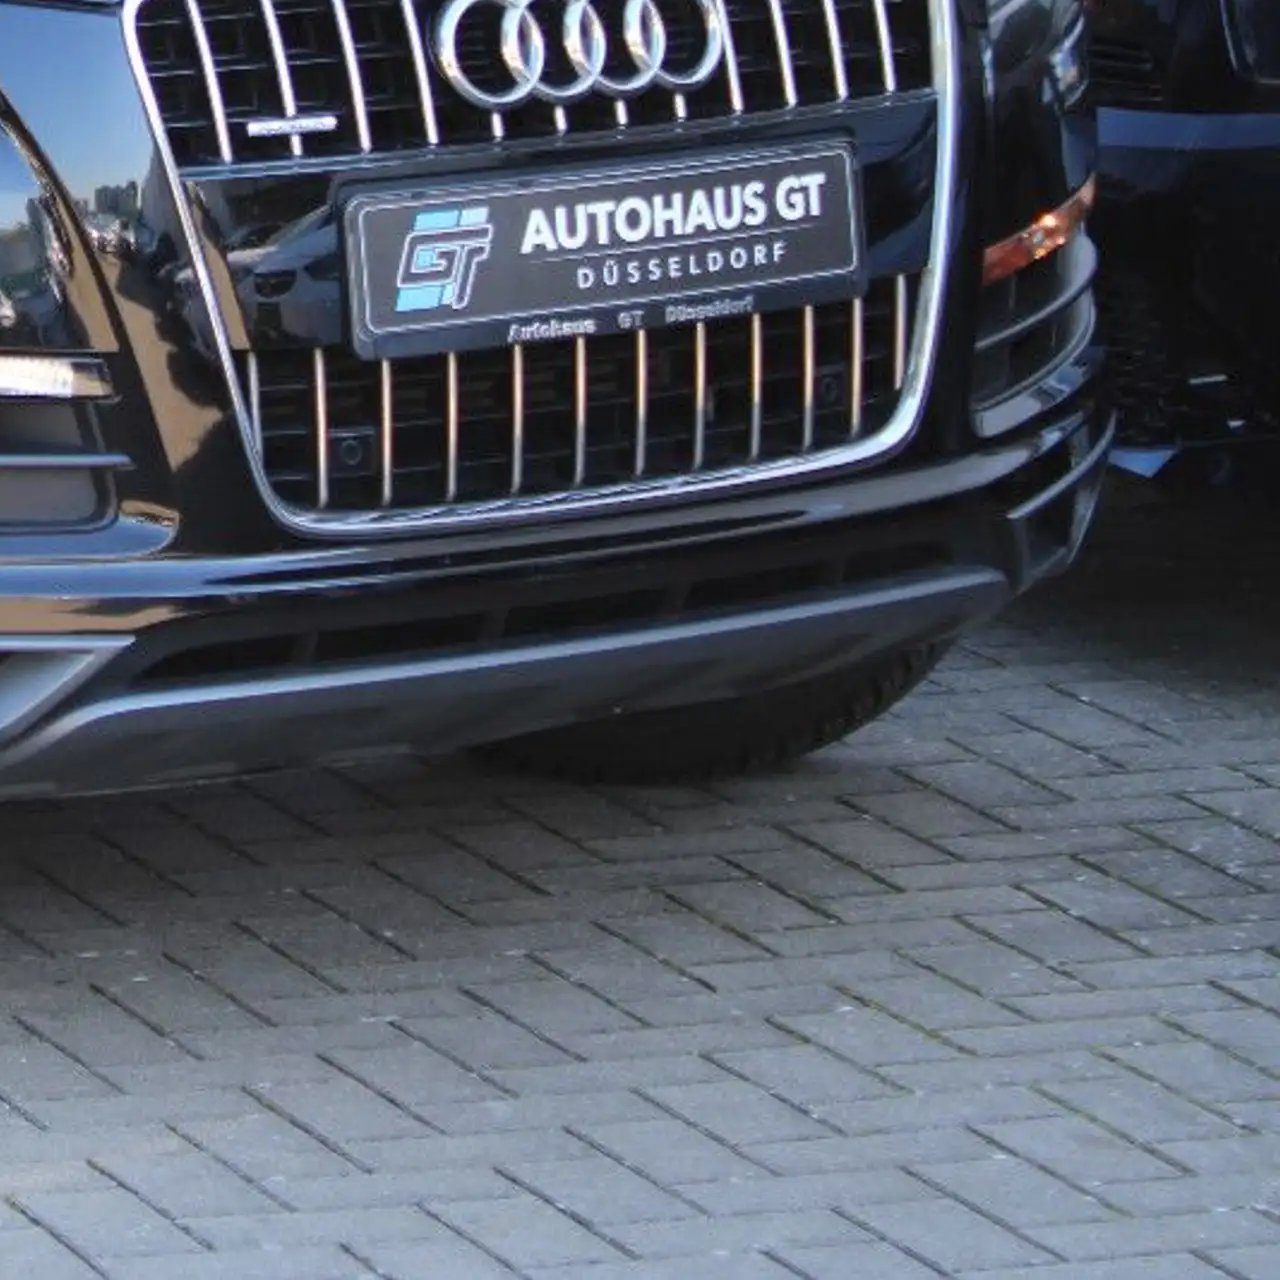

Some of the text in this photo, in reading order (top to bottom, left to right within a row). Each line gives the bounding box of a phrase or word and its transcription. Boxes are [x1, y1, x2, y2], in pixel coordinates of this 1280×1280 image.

[519, 171, 826, 254] AUTOHAUS GT
[576, 239, 788, 289] DÜSSELDORF
[617, 310, 645, 329] GT
